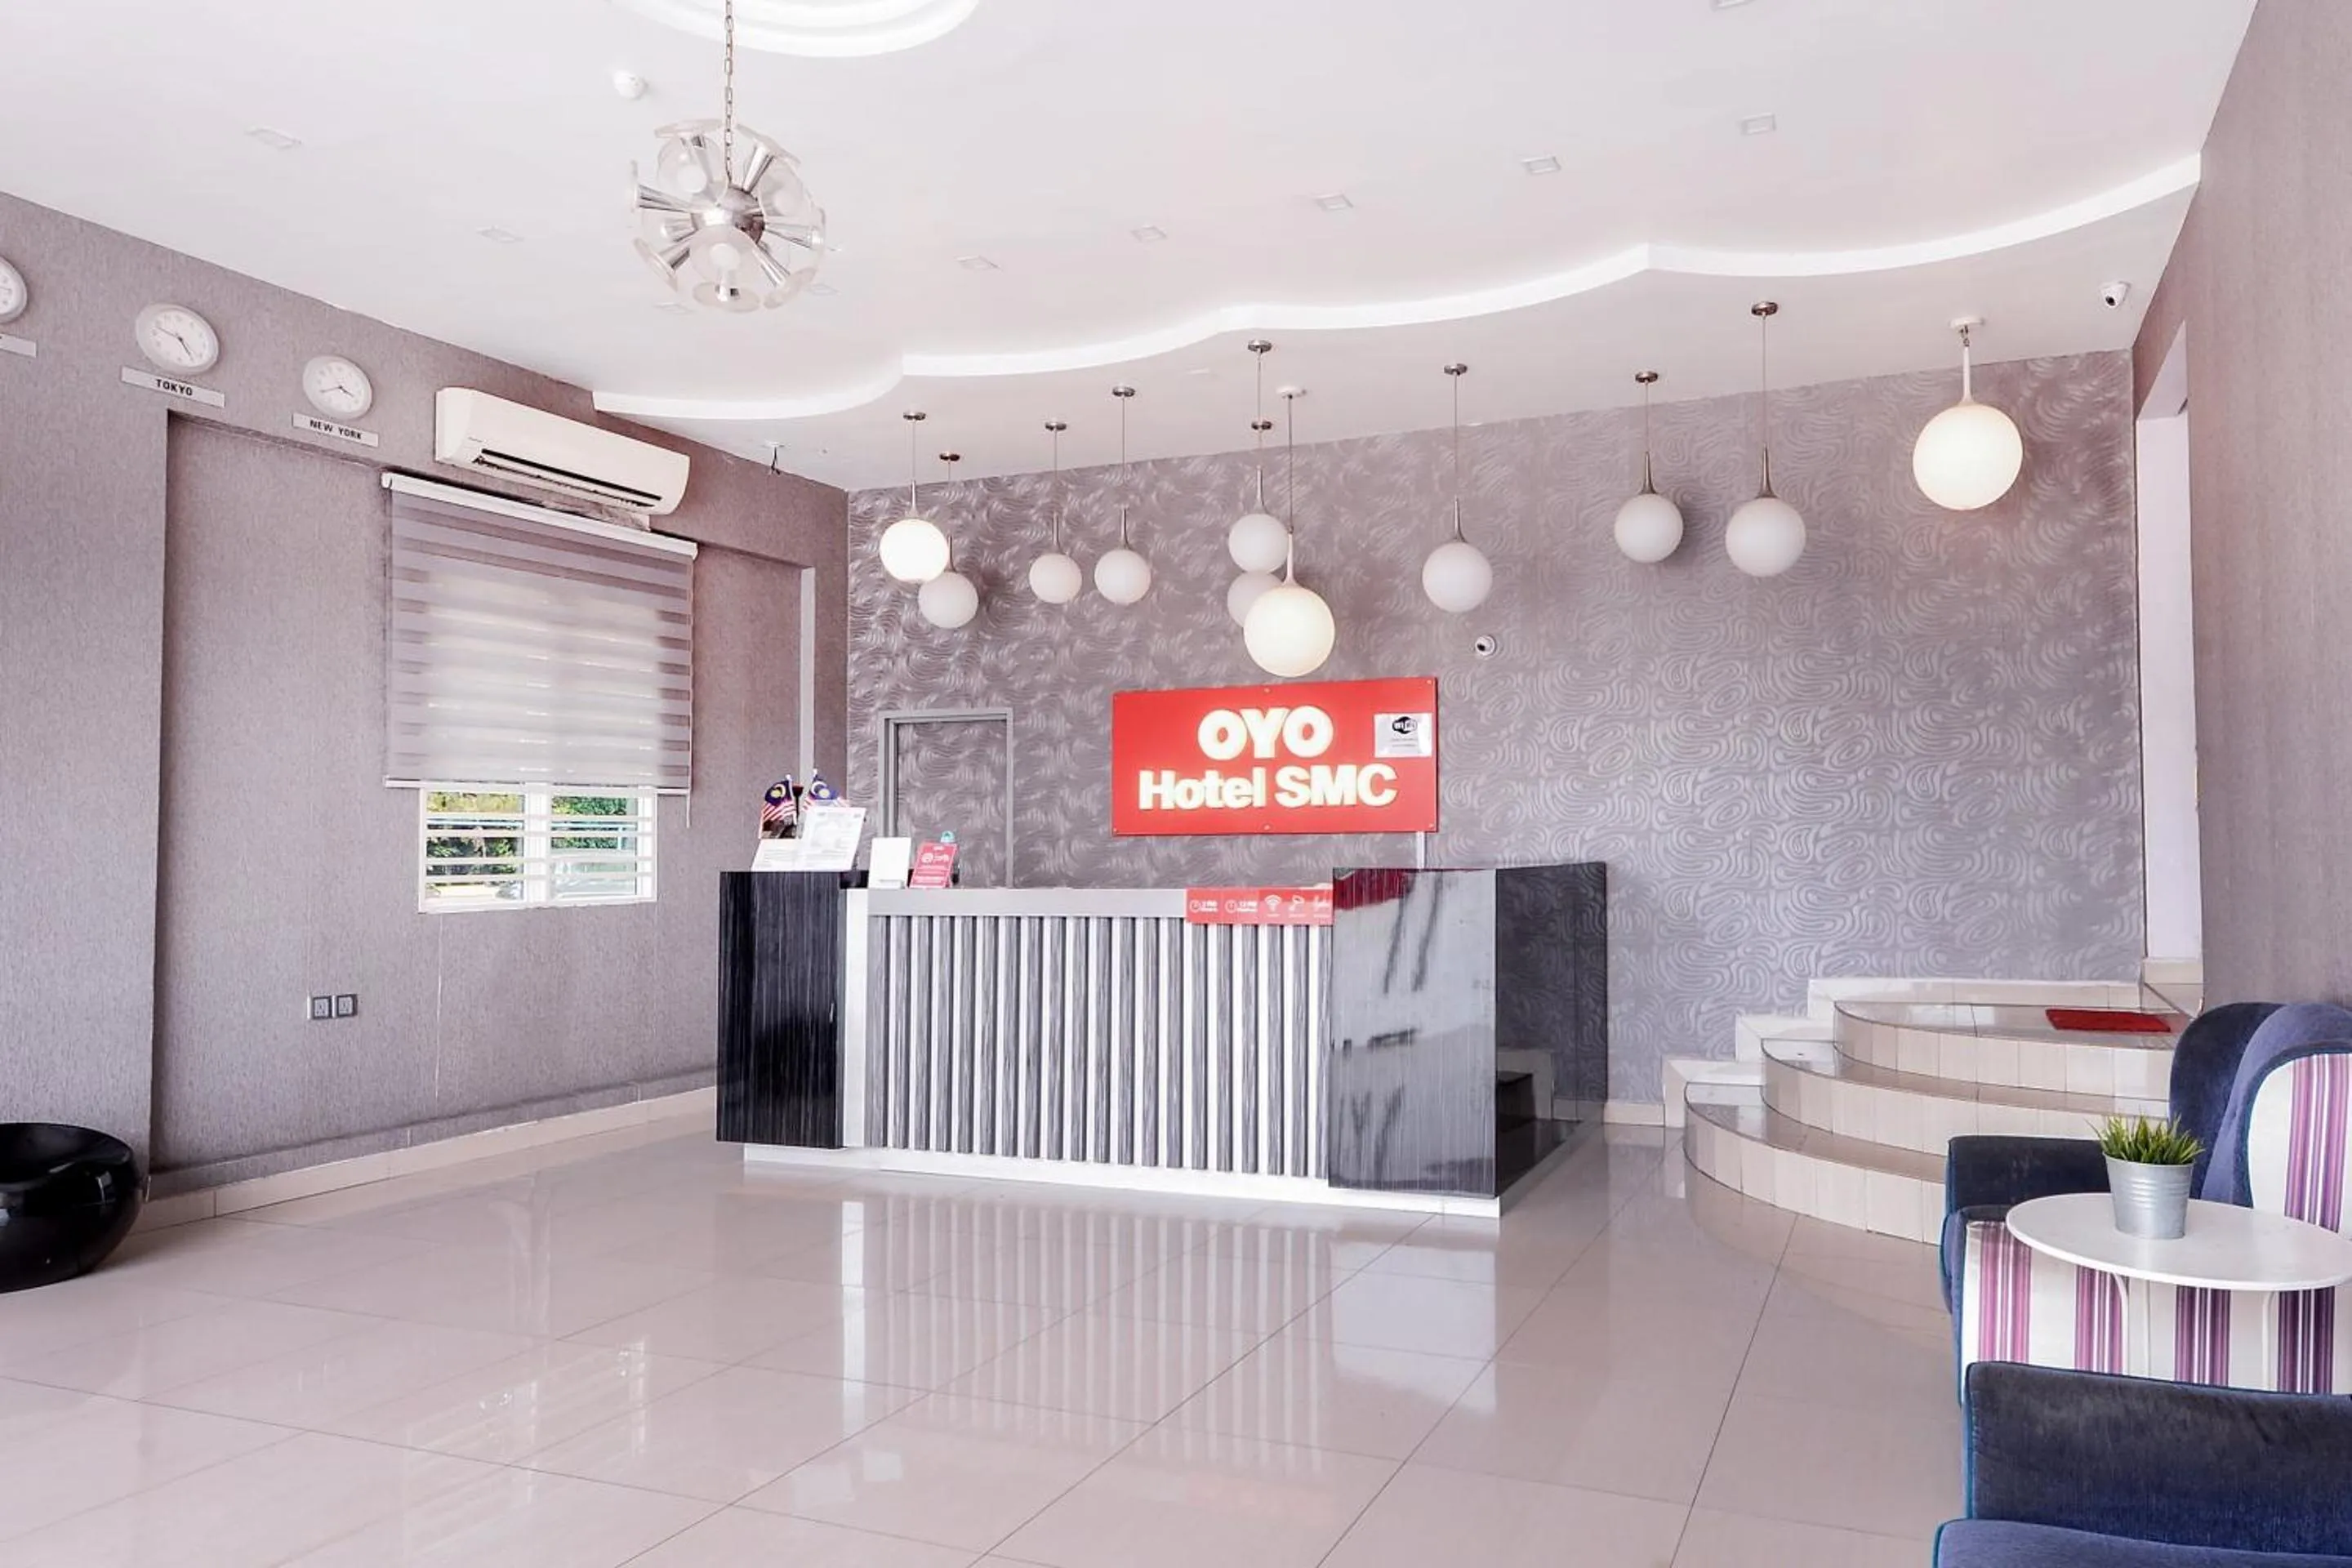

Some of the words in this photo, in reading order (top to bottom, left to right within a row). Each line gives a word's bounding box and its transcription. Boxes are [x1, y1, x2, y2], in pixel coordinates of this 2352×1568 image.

[156, 379, 193, 396] TOKYO
[310, 419, 333, 432] NEW
[338, 426, 362, 439] YORK
[1197, 705, 1334, 761] OYO
[1138, 766, 1267, 810] Hotel
[1274, 763, 1398, 808] SMC
